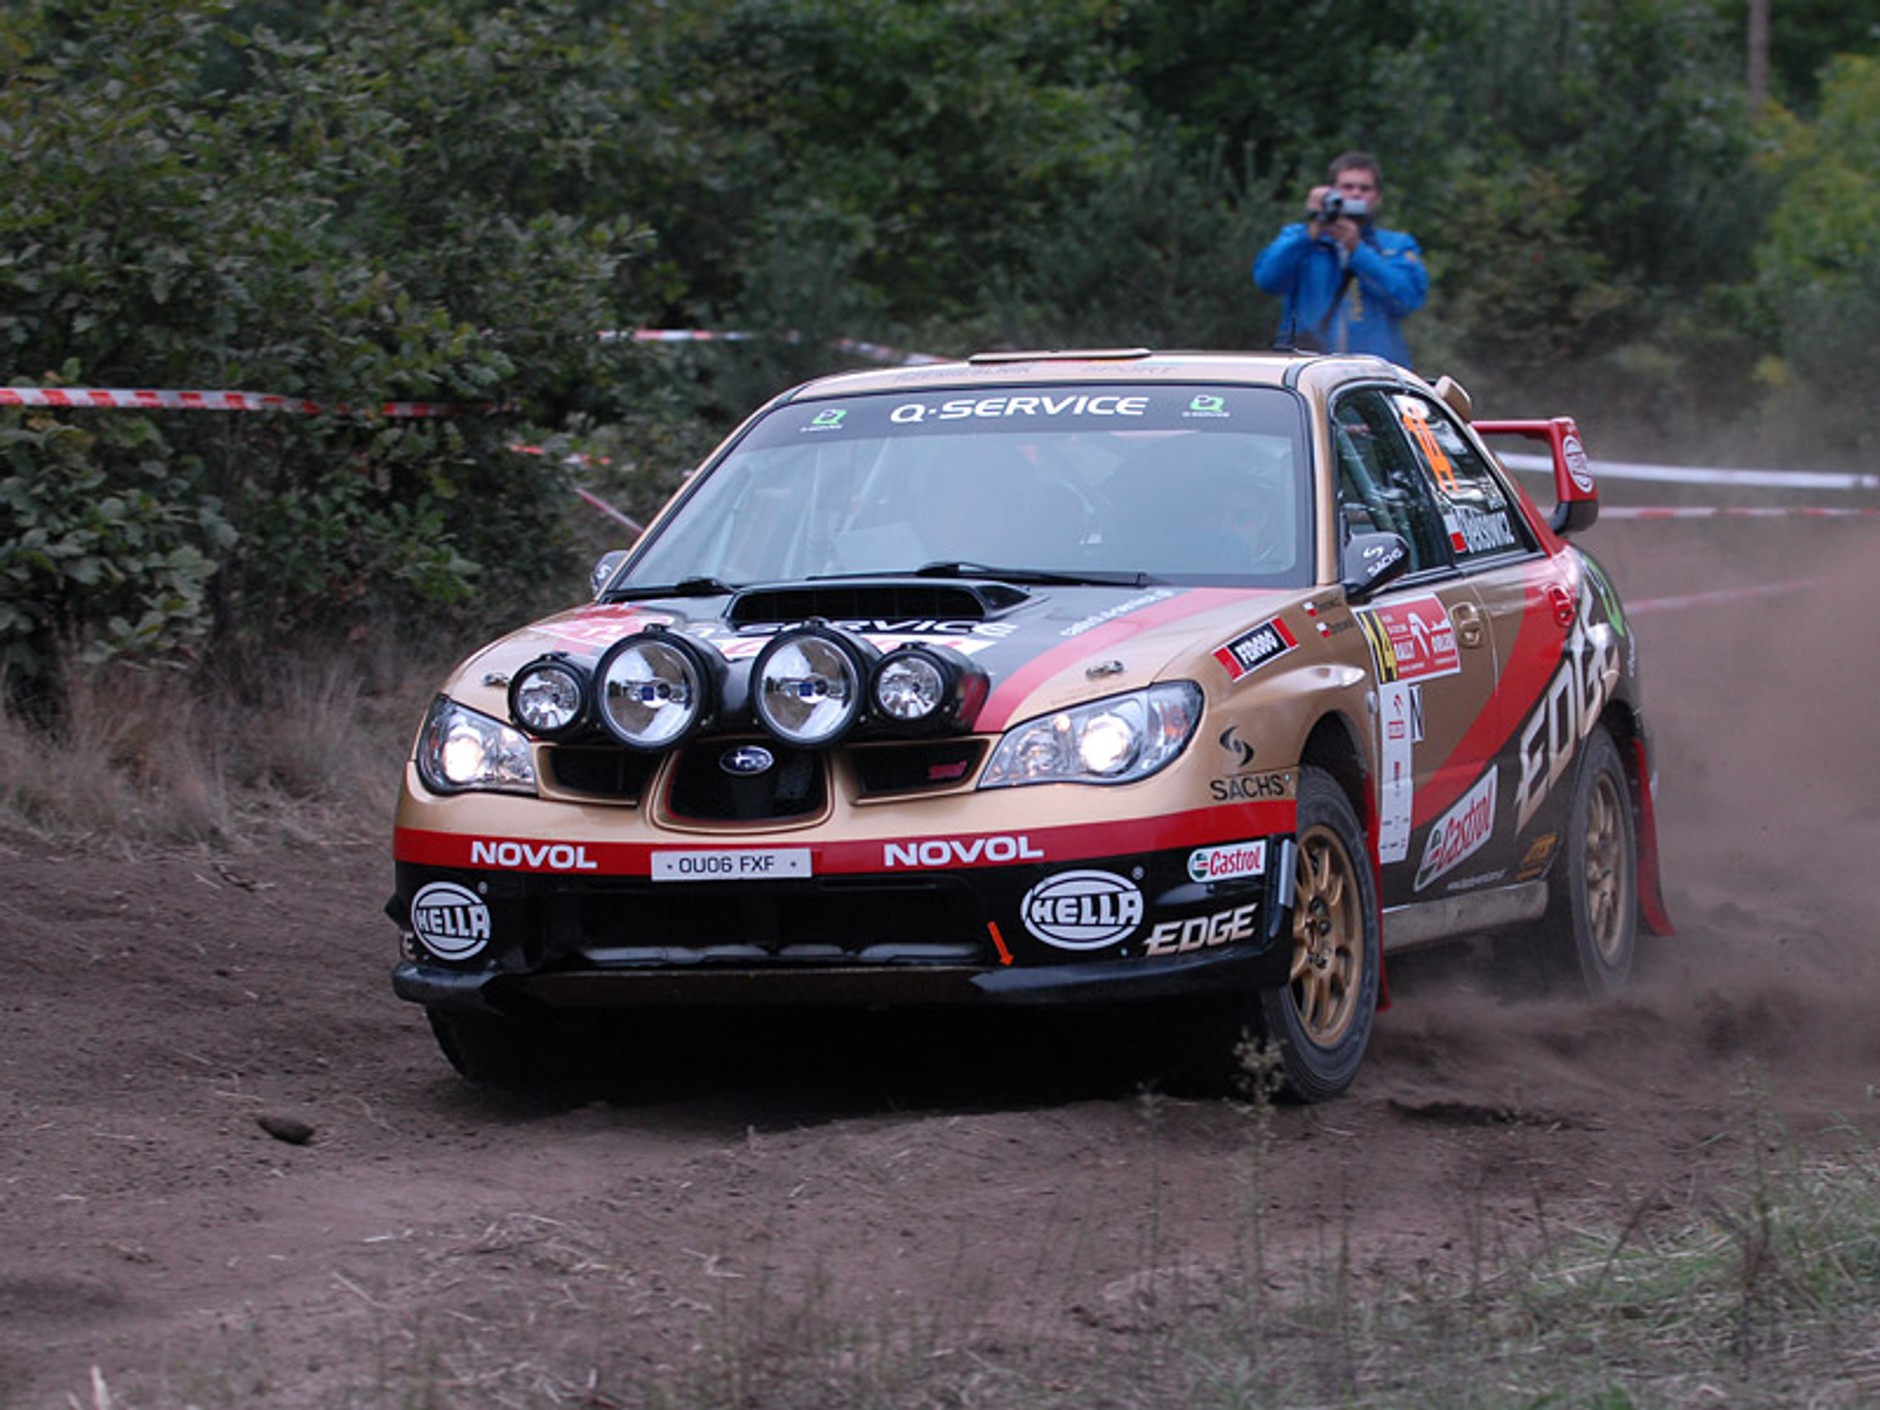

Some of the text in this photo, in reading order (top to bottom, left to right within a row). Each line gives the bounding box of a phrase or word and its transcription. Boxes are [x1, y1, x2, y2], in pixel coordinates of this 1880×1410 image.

[1210, 774, 1284, 801] SACHS
[1435, 779, 1494, 873] Castrol
[470, 840, 598, 869] NOVOL
[740, 855, 776, 871] FXF
[883, 836, 1044, 867] NOVOL
[1209, 846, 1261, 877] Castrol
[415, 904, 491, 939] HELLA
[1031, 890, 1144, 925] HELLA
[1141, 902, 1259, 956] EDGE
